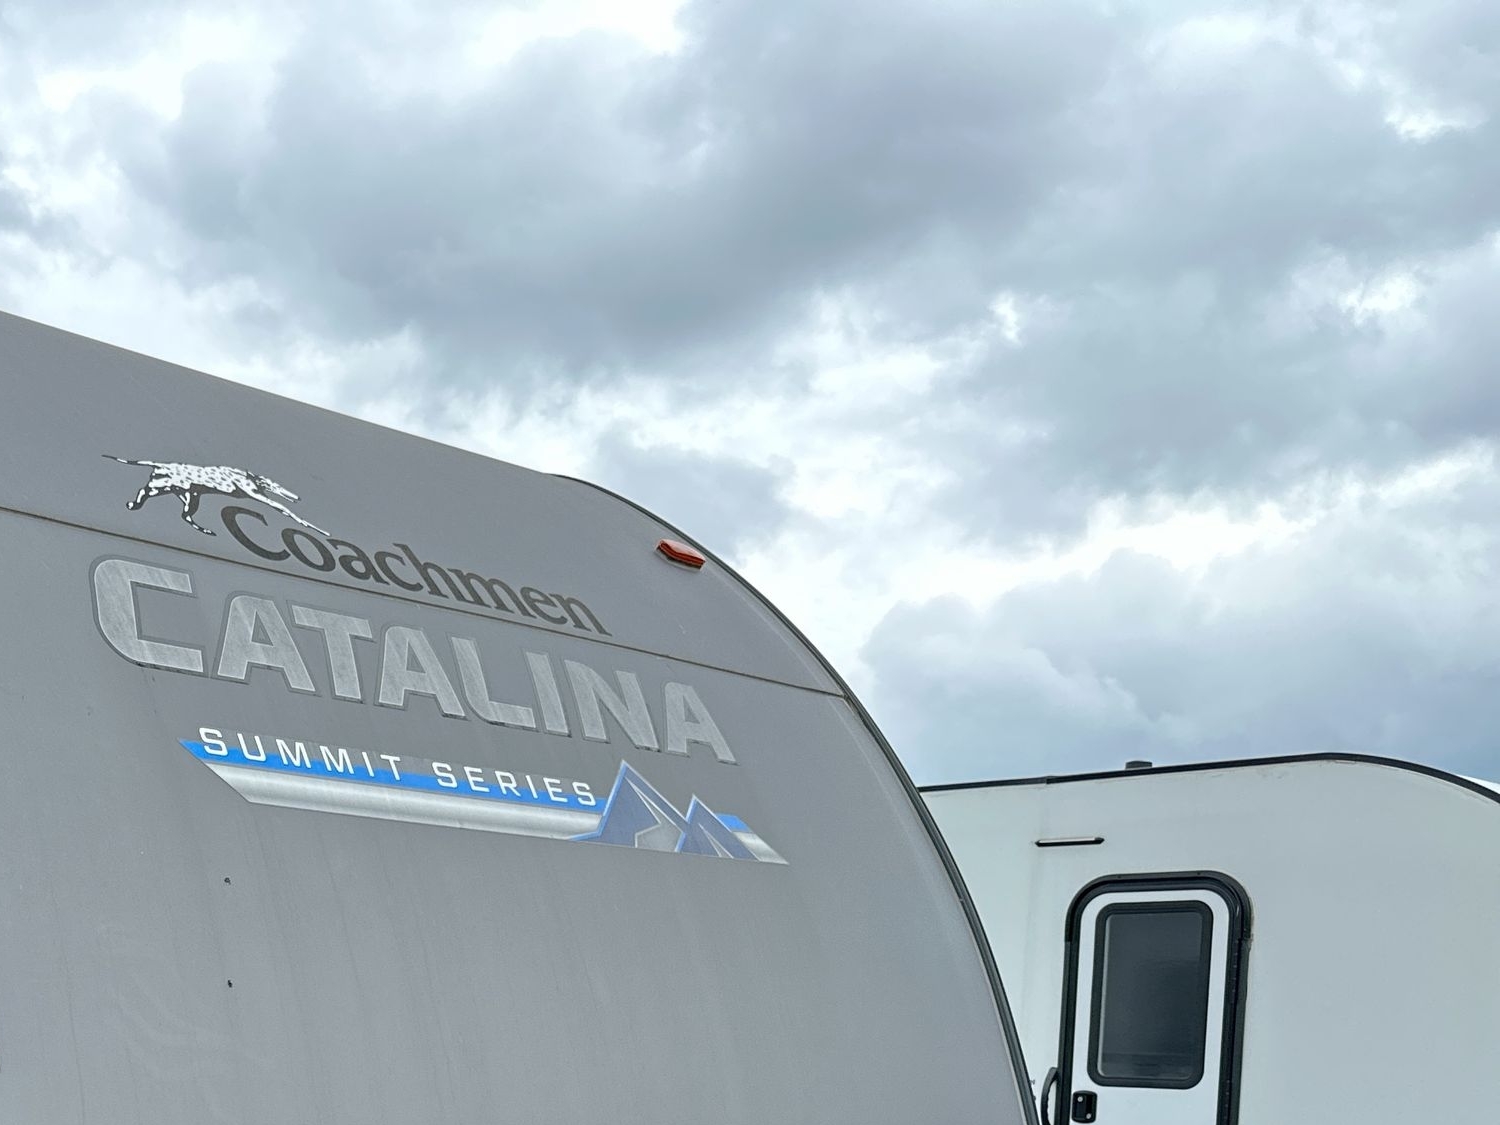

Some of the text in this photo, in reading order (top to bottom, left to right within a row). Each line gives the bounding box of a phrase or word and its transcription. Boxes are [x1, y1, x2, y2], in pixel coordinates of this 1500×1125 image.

[220, 505, 613, 637] Coachmen
[92, 556, 741, 765] CATALINA
[199, 727, 597, 807] SUMMIT SERIES
